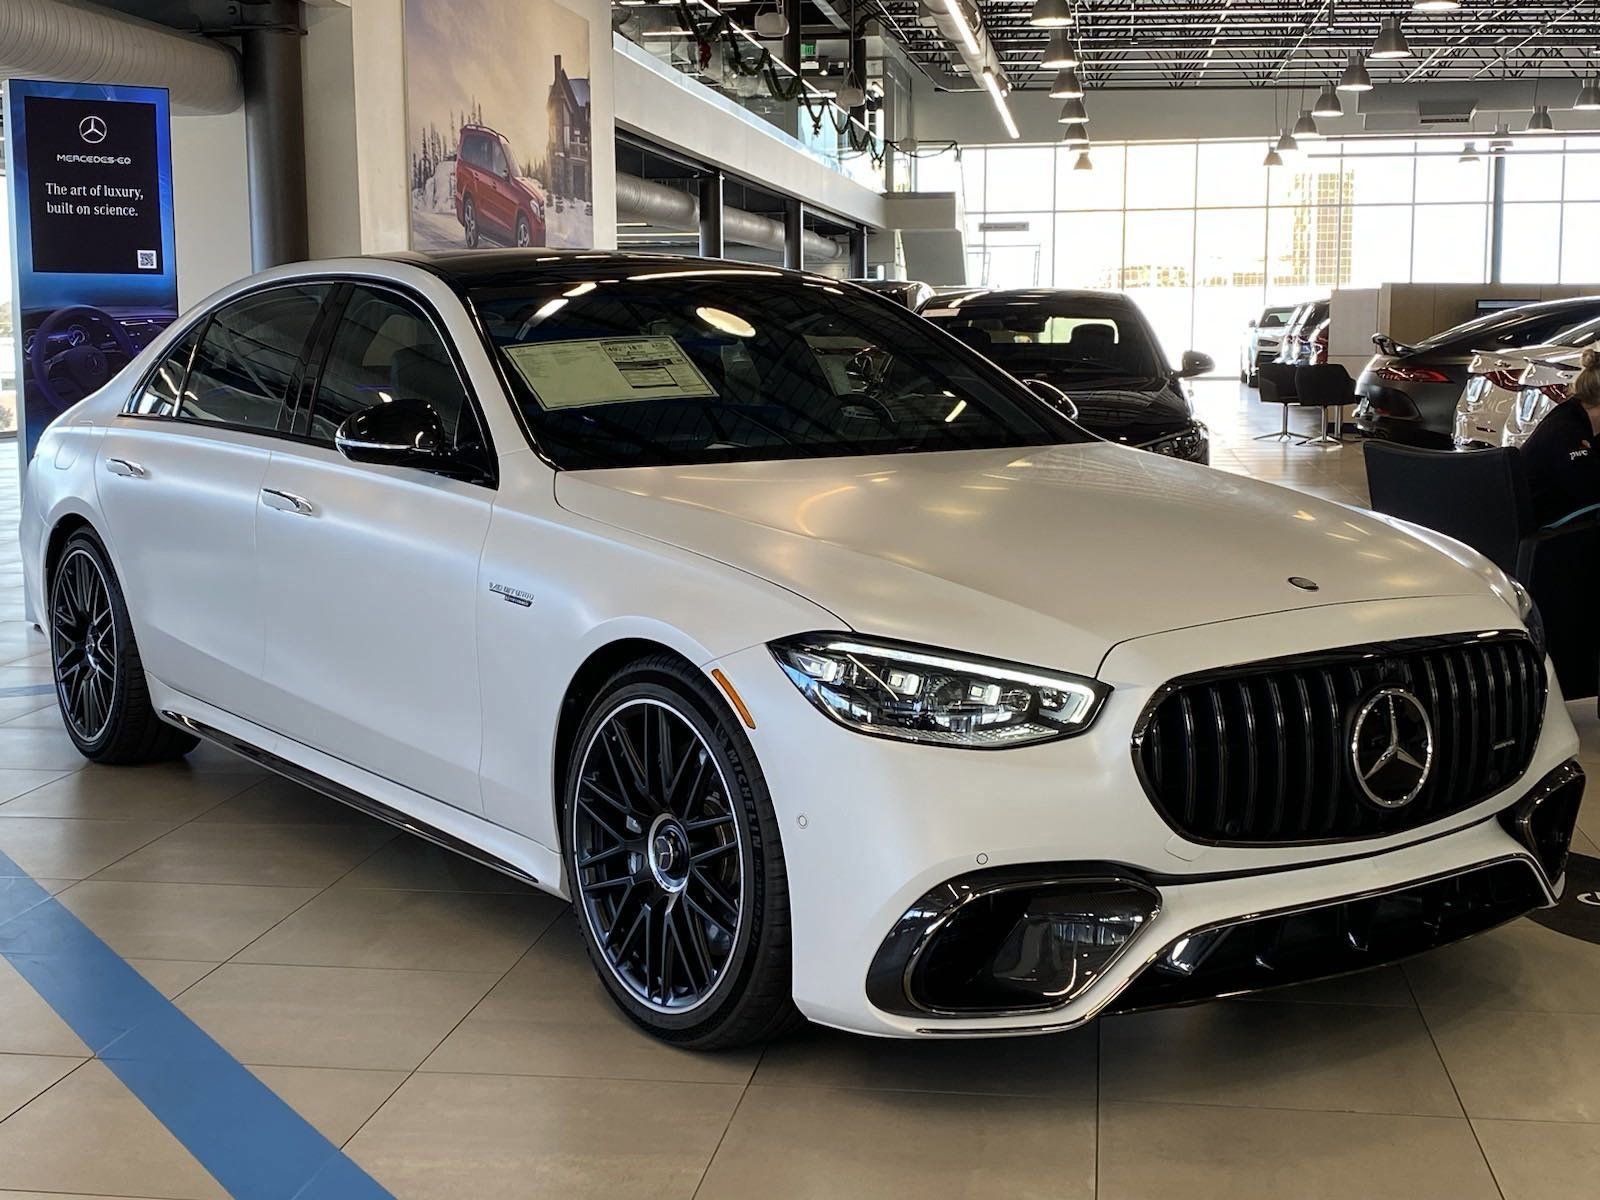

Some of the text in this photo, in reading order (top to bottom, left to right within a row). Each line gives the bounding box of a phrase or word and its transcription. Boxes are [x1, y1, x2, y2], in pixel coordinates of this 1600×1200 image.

[56, 154, 132, 165] MERCEDES-EQ
[46, 182, 144, 201] The art of luxury,
[46, 202, 139, 217] built on science.
[1569, 450, 1588, 461] pwc
[727, 750, 763, 848] MICHELIN
